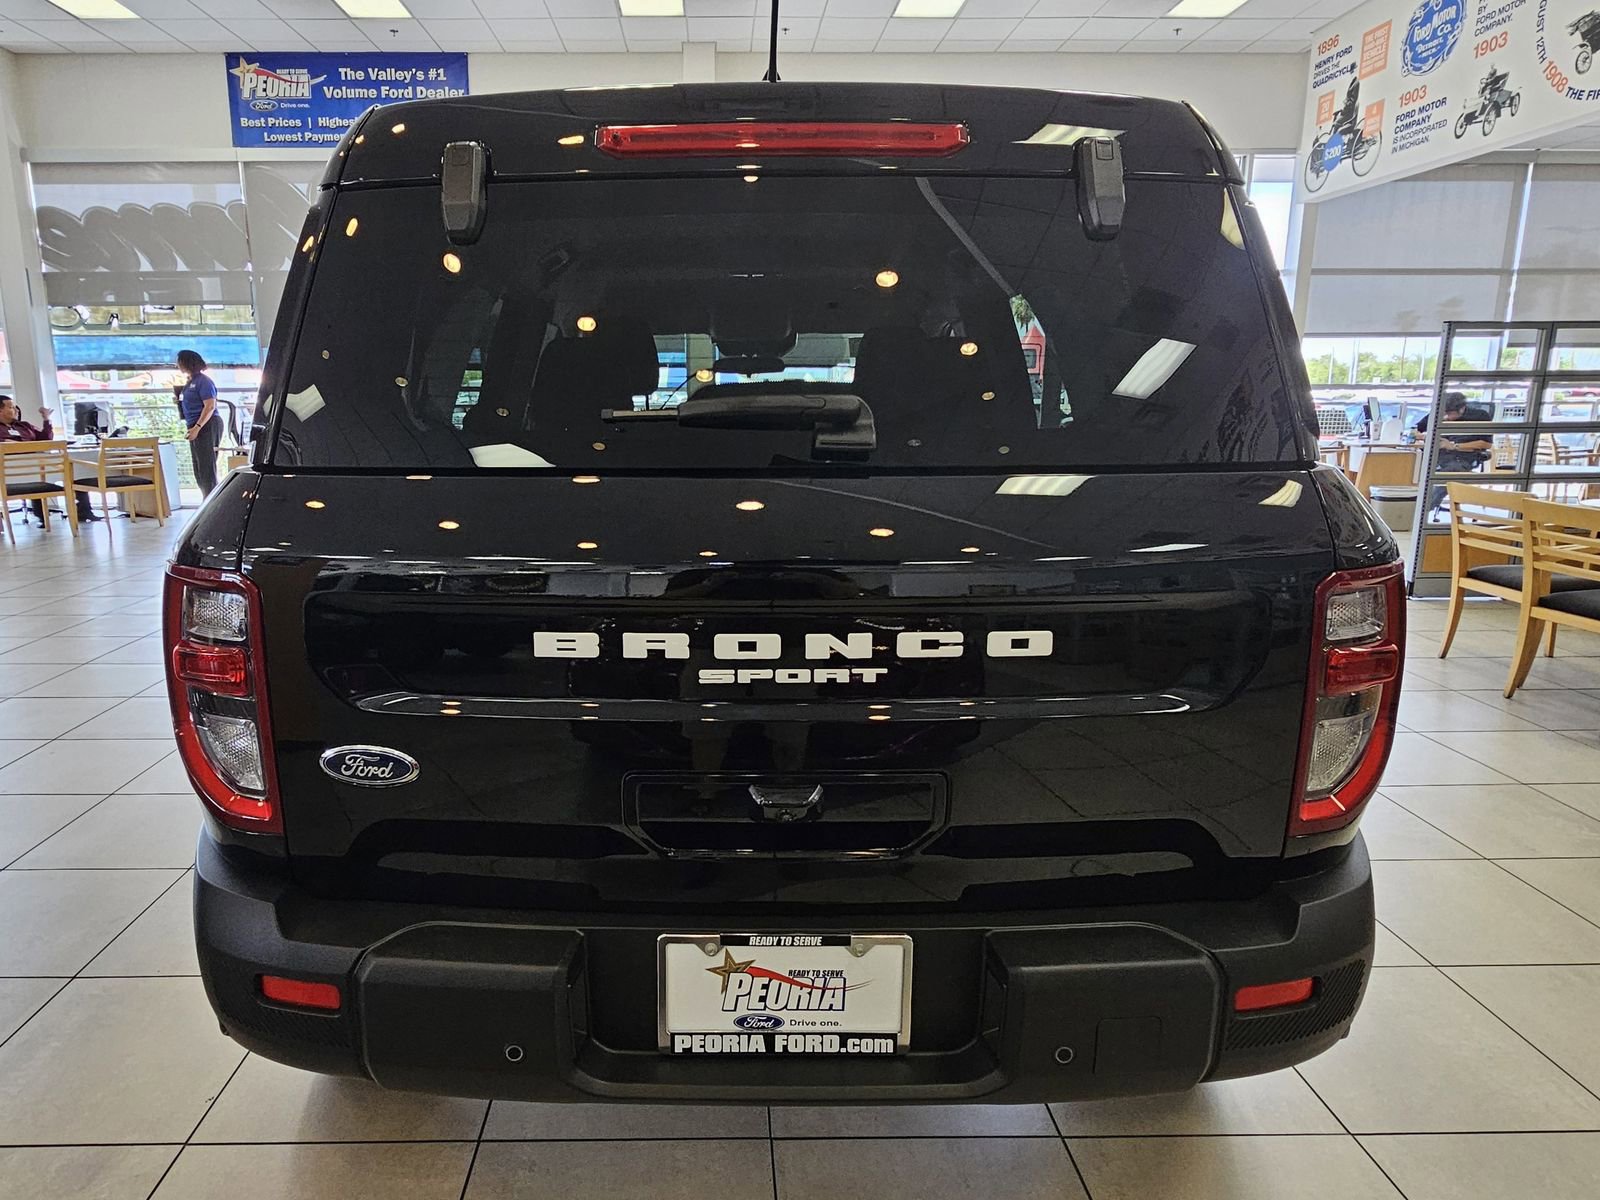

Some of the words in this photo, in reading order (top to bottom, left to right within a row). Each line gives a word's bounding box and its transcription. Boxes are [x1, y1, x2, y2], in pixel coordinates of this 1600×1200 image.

[1476, 10, 1496, 26] FORD
[1536, 0, 1548, 33] GUST
[1317, 34, 1339, 56] 1896
[1474, 31, 1508, 59] 1903
[1536, 36, 1548, 64] 12TH
[1314, 54, 1335, 71] HENRY
[1336, 45, 1353, 60] FORD
[339, 68, 365, 80] The
[368, 67, 425, 83] Valley's
[428, 68, 447, 81] #1
[1313, 65, 1331, 80] DRIVES
[1543, 60, 1568, 93] 1908
[1565, 86, 1585, 100] THE
[241, 73, 311, 99] PEORIA
[323, 86, 377, 99] Volume
[381, 86, 413, 99] Ford
[416, 86, 465, 99] Dealer
[1399, 85, 1427, 108] 1903
[1396, 109, 1416, 124] FORD
[1418, 97, 1447, 115] MOTOR
[240, 117, 265, 127] Best
[268, 117, 302, 127] Prices
[1394, 113, 1432, 134] COMPANY
[1399, 119, 1447, 142] INCORPORATED
[264, 132, 303, 142] Lowest
[533, 630, 1054, 660] BRONCO
[699, 668, 889, 684] SPORT
[749, 936, 778, 946] READY
[780, 936, 793, 946] TO
[793, 936, 822, 946] SERVE
[722, 971, 846, 1011] PEORIA
[674, 1034, 766, 1053] PEORIA
[774, 1034, 894, 1053] FORD.com
